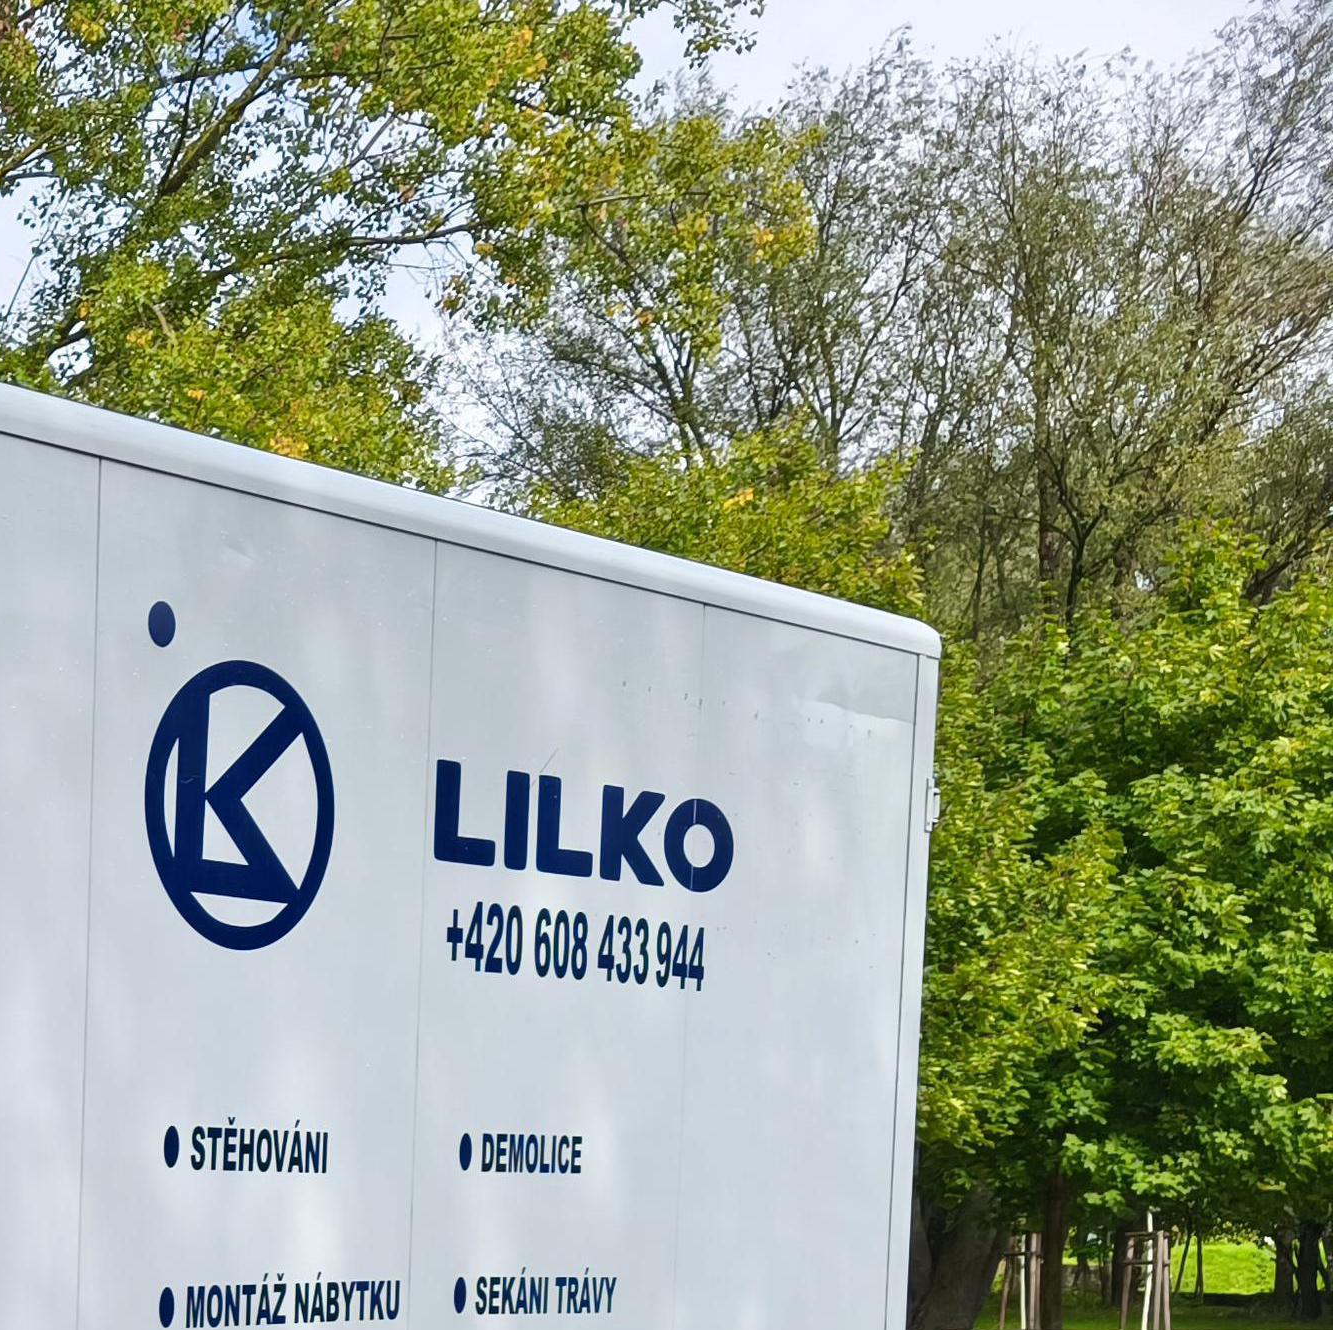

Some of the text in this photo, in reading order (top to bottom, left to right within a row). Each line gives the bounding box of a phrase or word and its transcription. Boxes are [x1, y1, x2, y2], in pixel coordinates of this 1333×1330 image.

[433, 759, 734, 893] LILKO
[446, 901, 705, 992] +420 608 433 944
[190, 1116, 329, 1174] STĚHOVÁNI
[481, 1133, 583, 1174] DEMOLICE
[185, 1271, 401, 1328] MONTÁŽ NÁBYTKU
[475, 1267, 617, 1315] SEKÁNI TRÁVY
